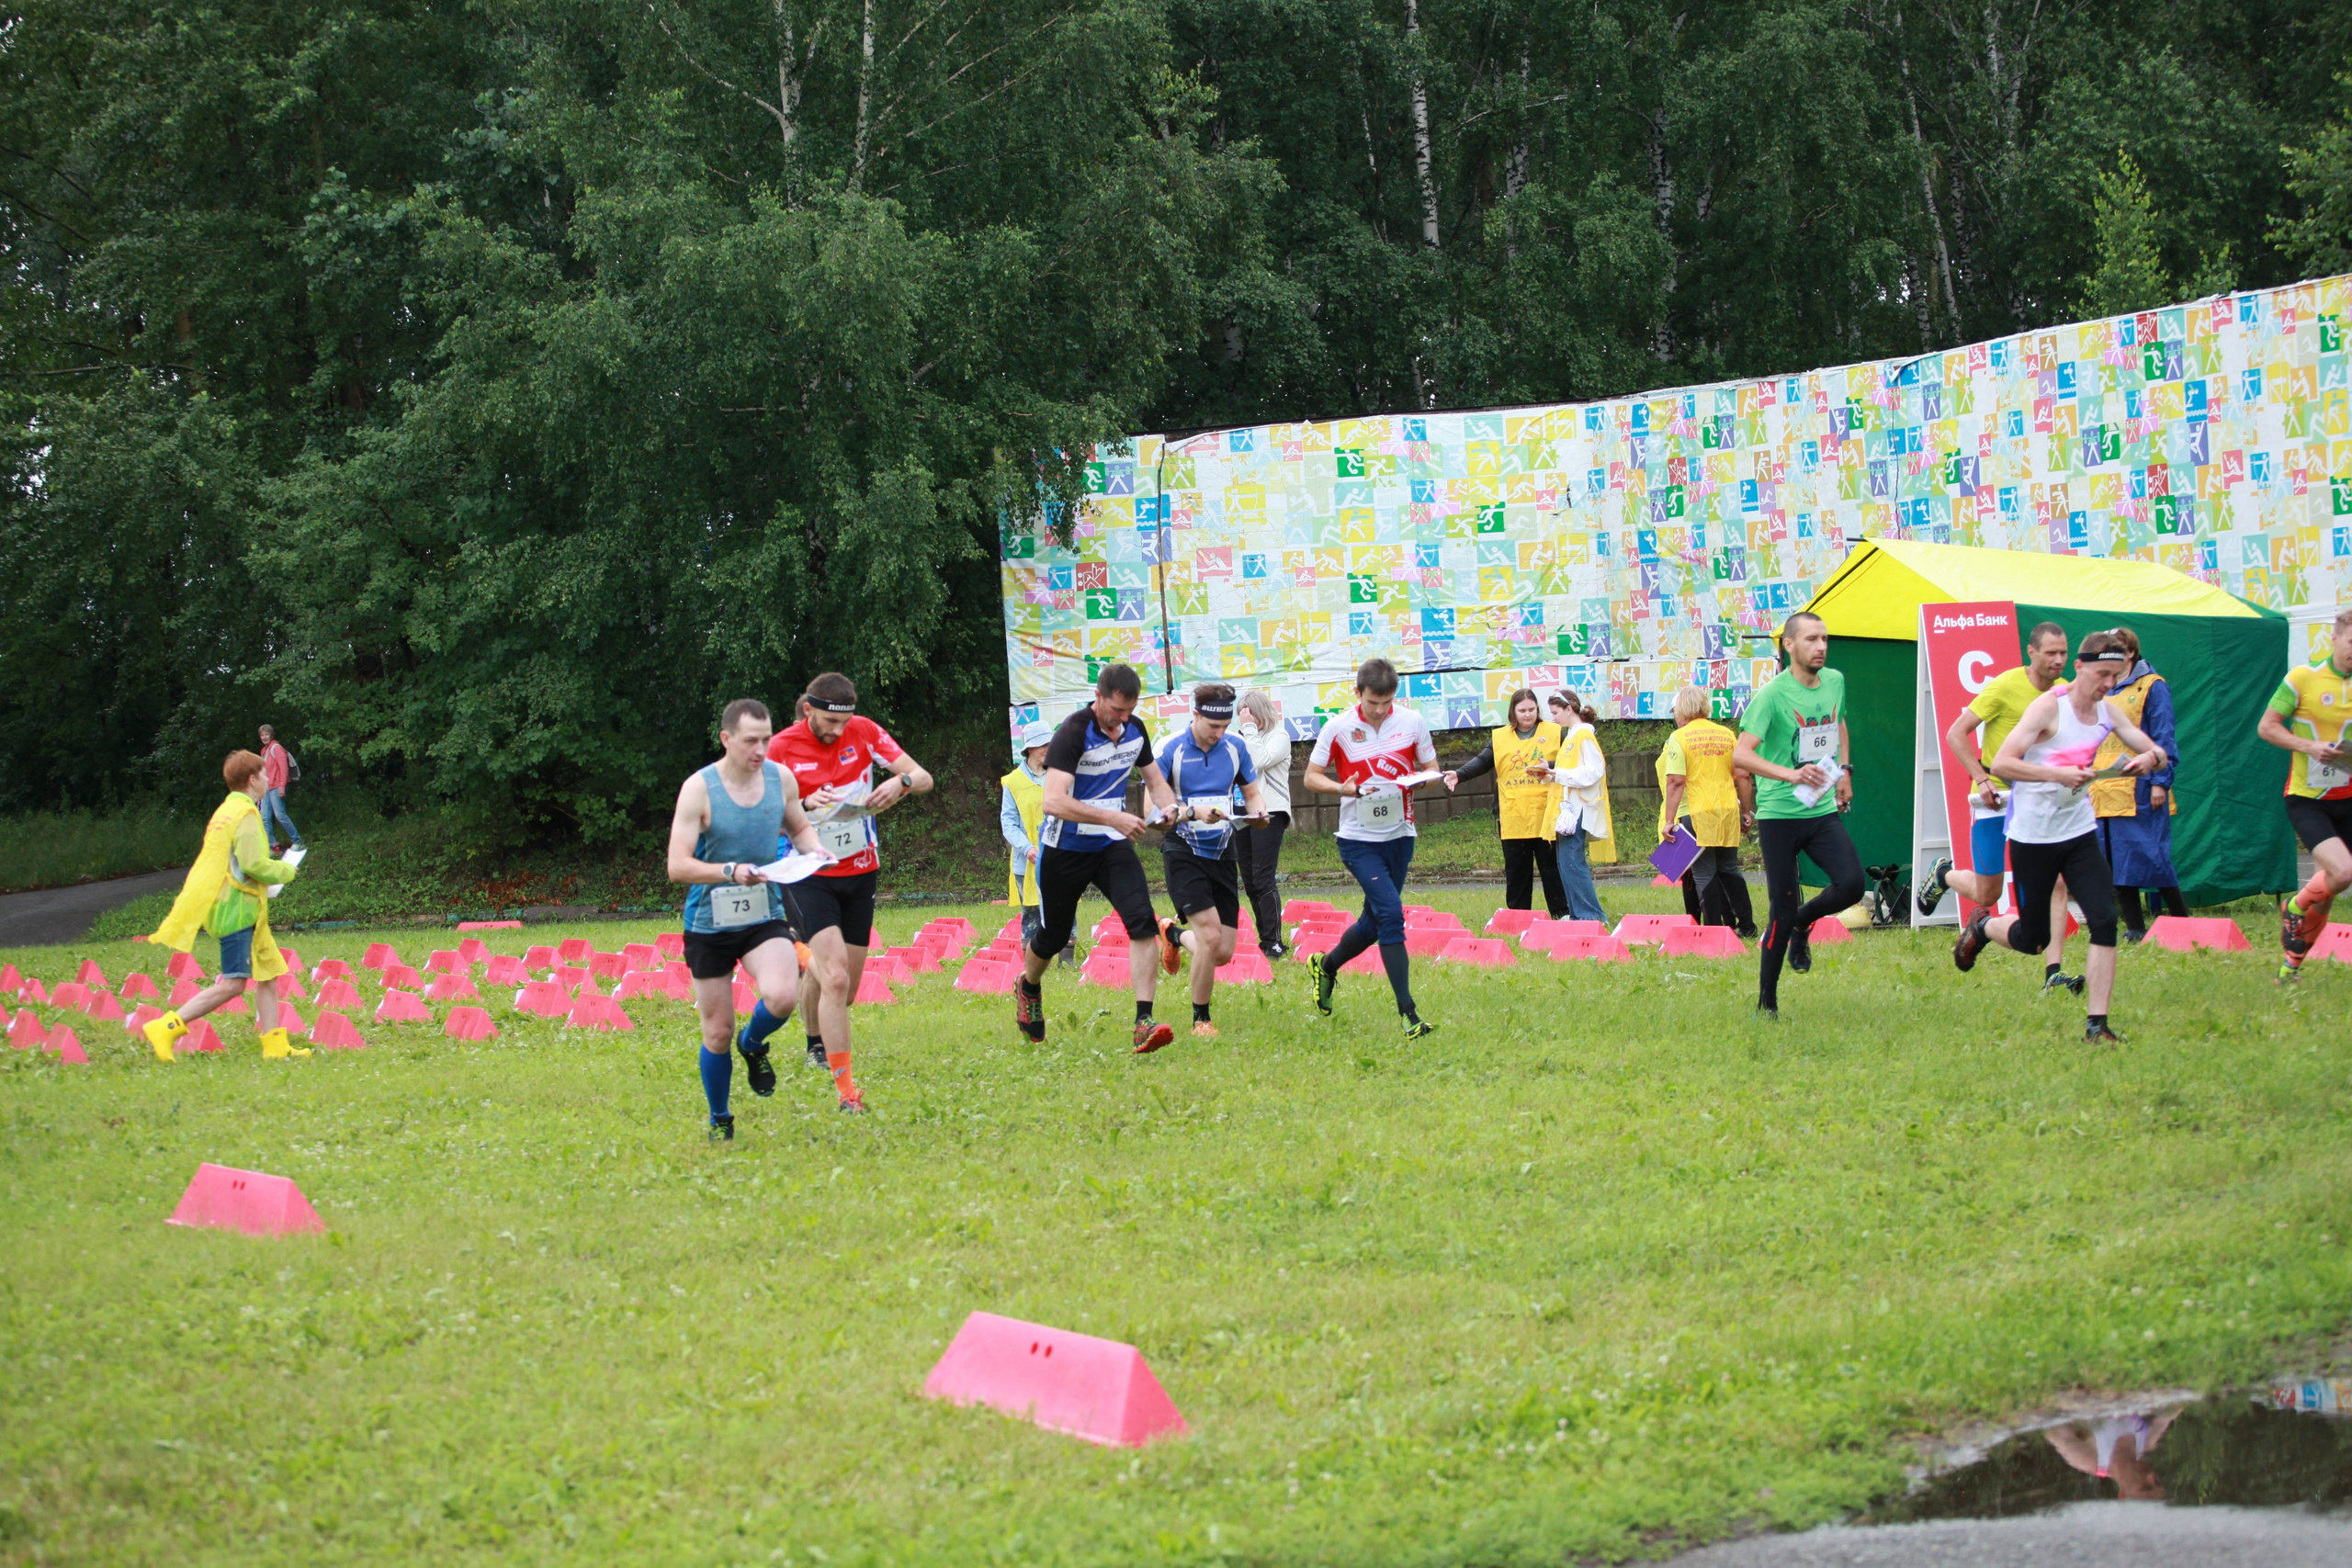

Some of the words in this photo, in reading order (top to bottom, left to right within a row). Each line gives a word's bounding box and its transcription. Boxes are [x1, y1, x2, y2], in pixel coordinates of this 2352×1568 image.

[1933, 615, 1974, 630] Альфа
[1976, 614, 2007, 626] Банк
[1814, 736, 1826, 748] 66
[1376, 758, 1398, 775] Run
[2322, 766, 2335, 777] 61
[1373, 806, 1388, 818] 68
[834, 832, 852, 847] 72
[732, 899, 751, 913] 73
